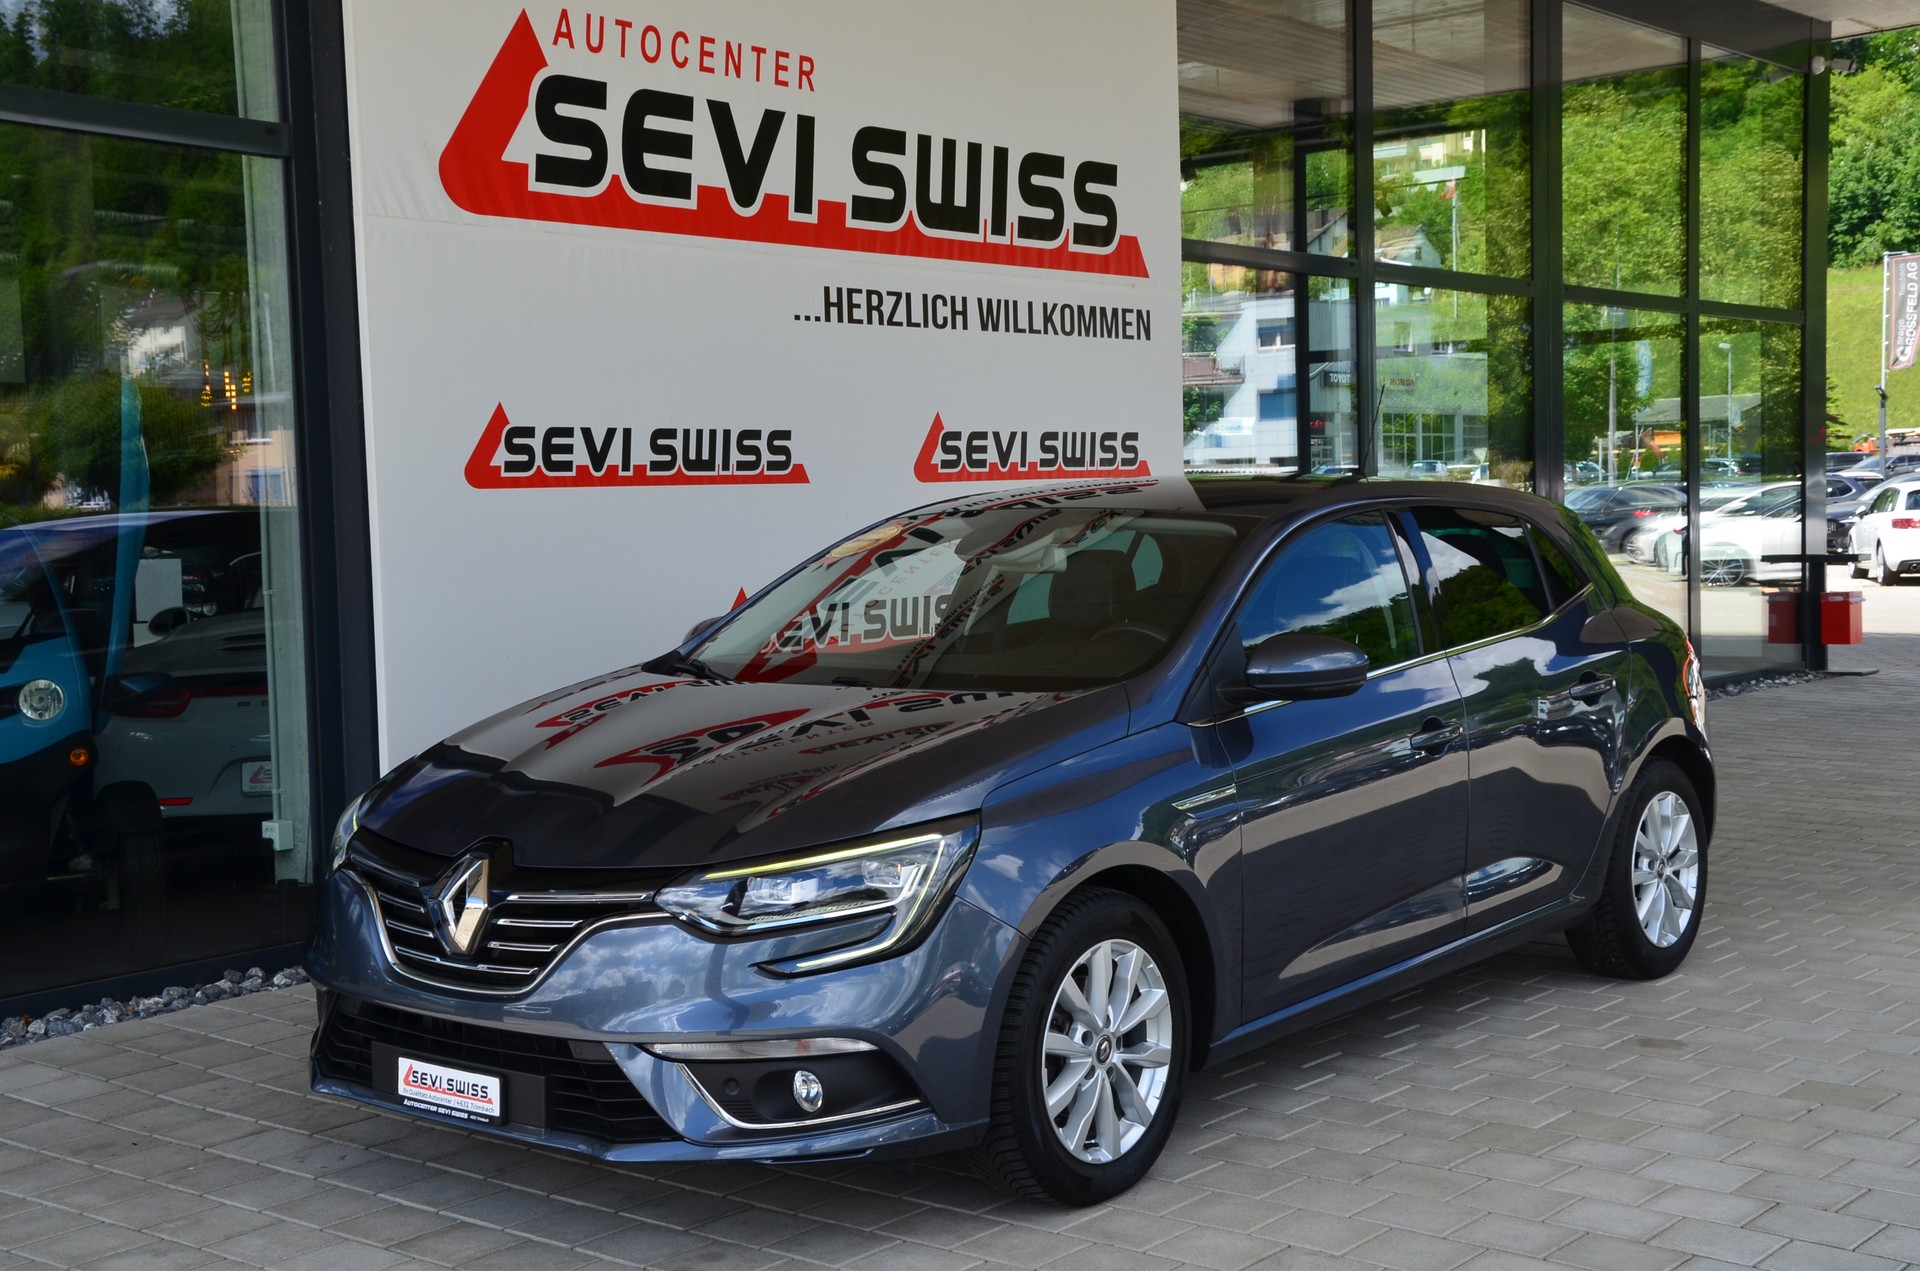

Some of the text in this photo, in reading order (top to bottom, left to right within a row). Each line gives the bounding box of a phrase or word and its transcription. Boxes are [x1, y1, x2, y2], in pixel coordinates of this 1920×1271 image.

[553, 8, 816, 92] AUTOCENTER
[534, 73, 1118, 249] SEVI SWISS
[1907, 262, 1918, 280] AG
[794, 286, 1152, 342] ...HERZLICH WILLKOMMEN
[1329, 373, 1351, 384] TOYOT
[504, 426, 793, 473] SEVI SWISS
[939, 430, 1139, 470] SEVI SWISS
[411, 1070, 488, 1099] SEVI SWISS
[428, 1094, 452, 1104] Autocenter
[470, 1103, 495, 1113] Trimbach
